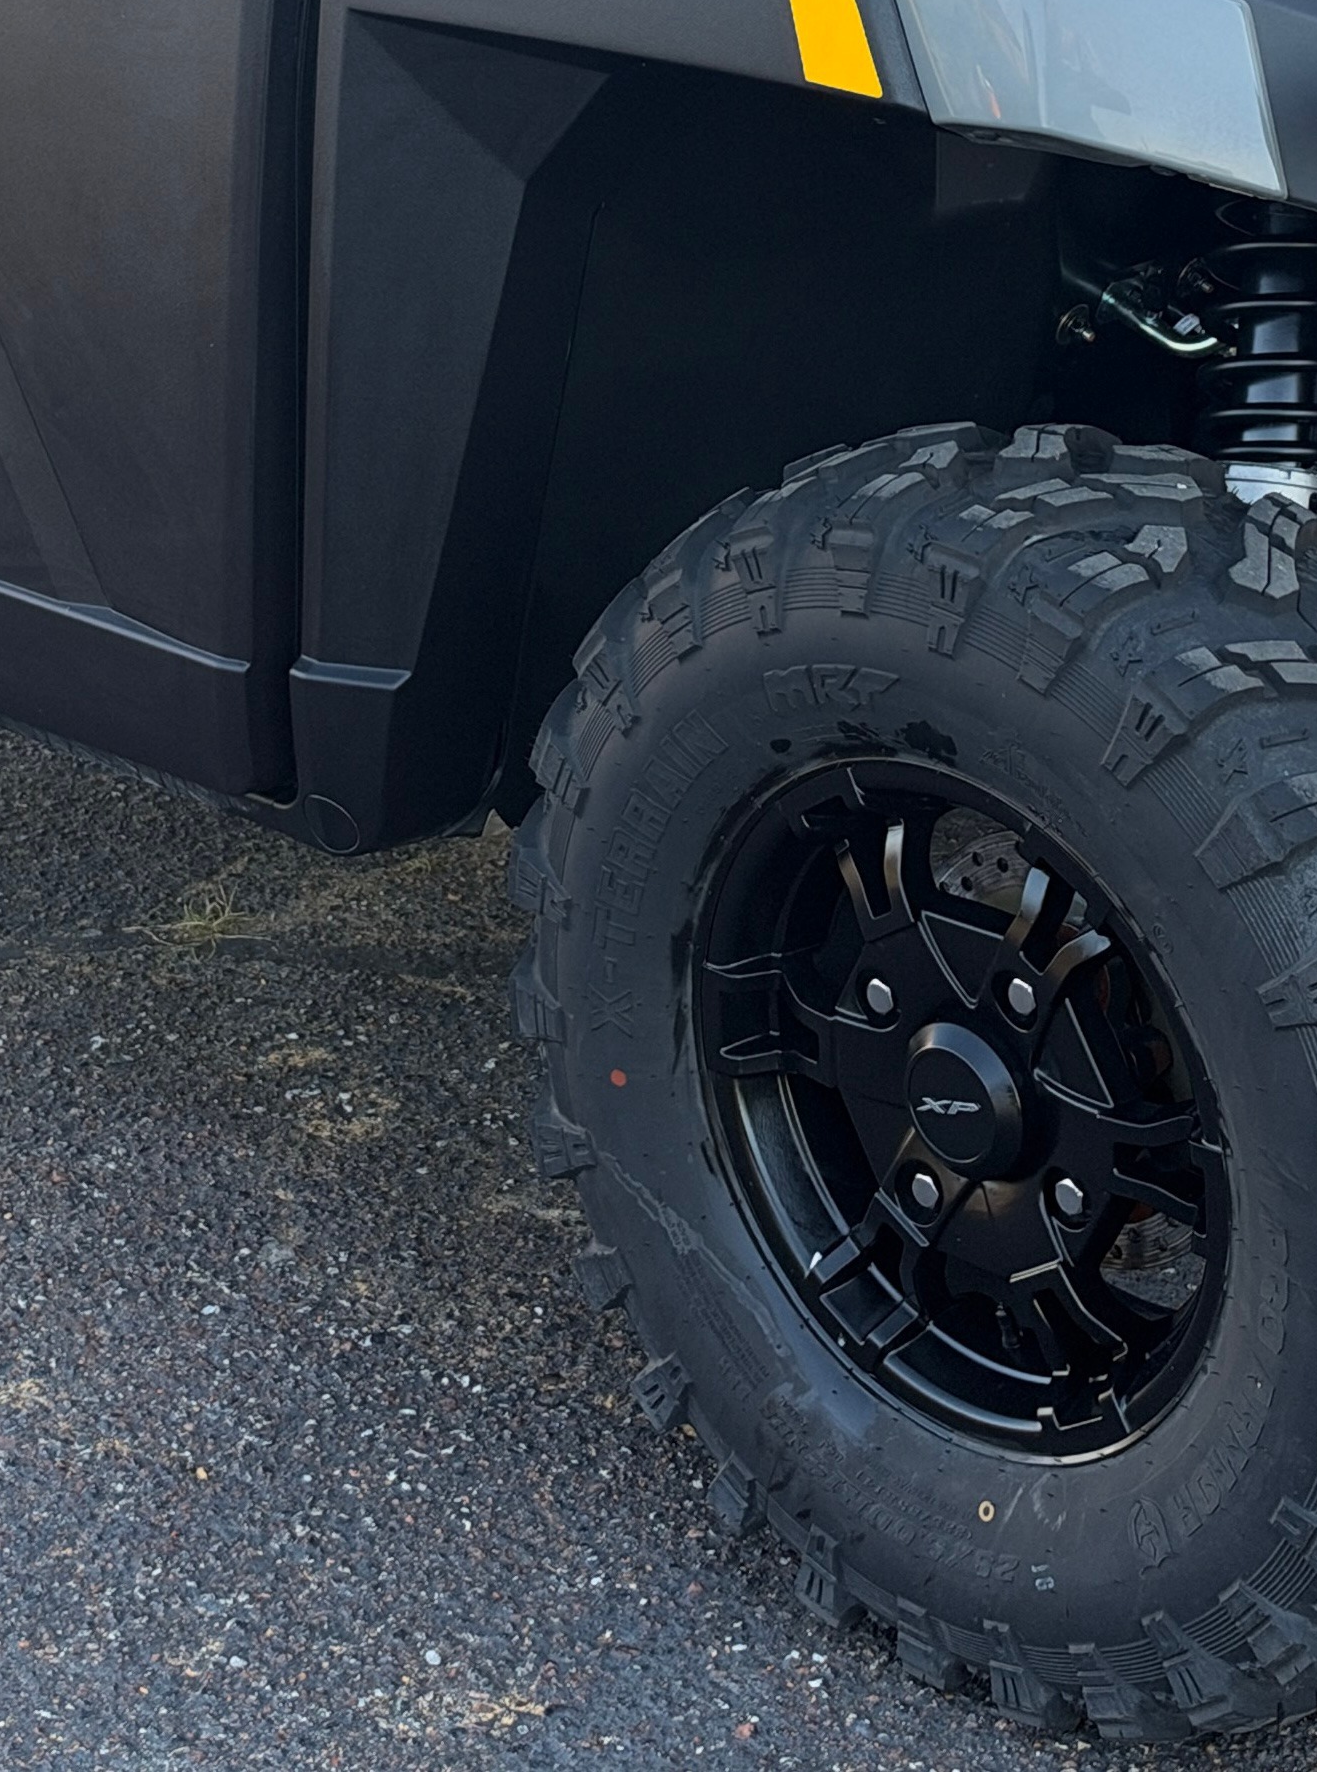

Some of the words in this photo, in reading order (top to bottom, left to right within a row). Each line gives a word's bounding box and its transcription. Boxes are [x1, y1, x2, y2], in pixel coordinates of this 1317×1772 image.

[763, 663, 900, 712] MRT
[586, 708, 729, 1039] X-TERRAIN
[916, 1097, 981, 1115] XP
